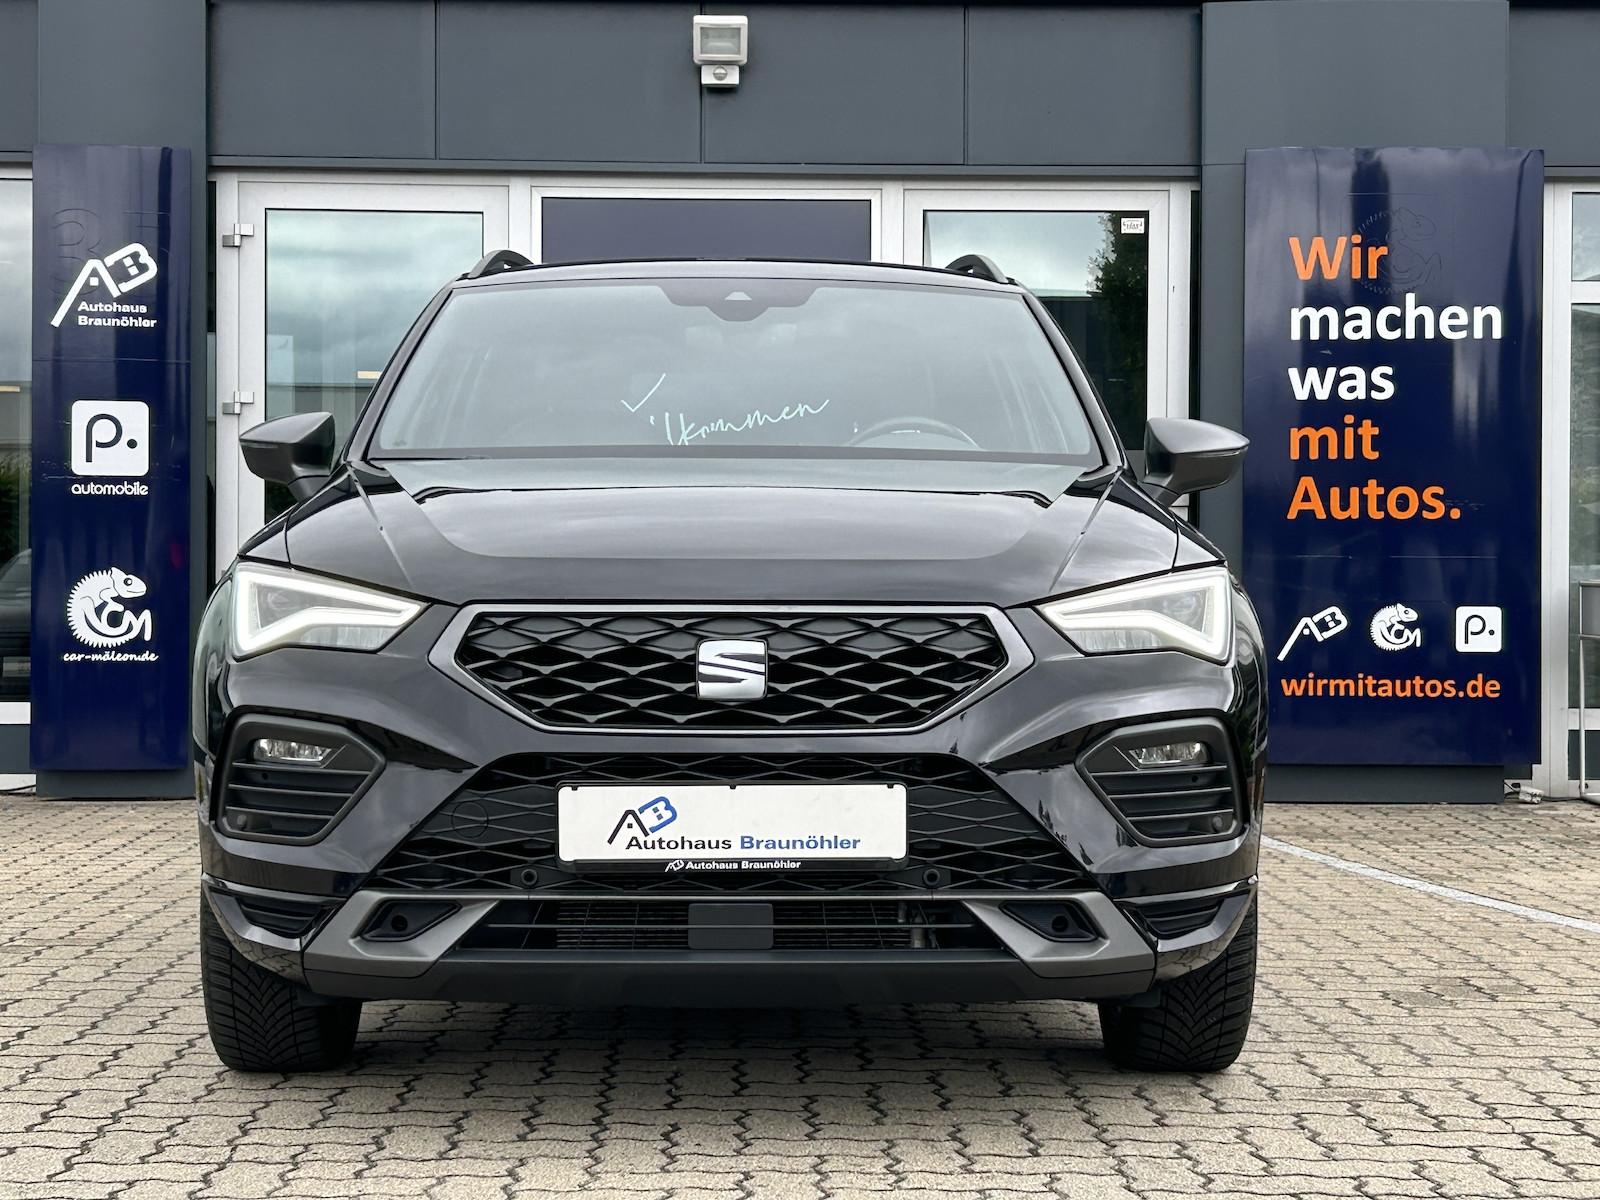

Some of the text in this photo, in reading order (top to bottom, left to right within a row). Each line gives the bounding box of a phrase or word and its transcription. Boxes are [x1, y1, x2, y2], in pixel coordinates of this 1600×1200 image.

[1288, 234, 1389, 280] Wir
[77, 301, 148, 314] Autohaus
[77, 315, 158, 328] Braunöhler
[1289, 292, 1503, 341] machen
[1287, 366, 1396, 401] was
[1289, 414, 1380, 461] mit
[71, 481, 149, 496] automobile
[1286, 476, 1462, 520] Autos.
[1280, 671, 1502, 699] wirmitautos.de
[625, 834, 861, 851] Autohaus Braunöhler
[685, 860, 739, 871] Autohaus
[741, 859, 802, 870] Braunöhler
